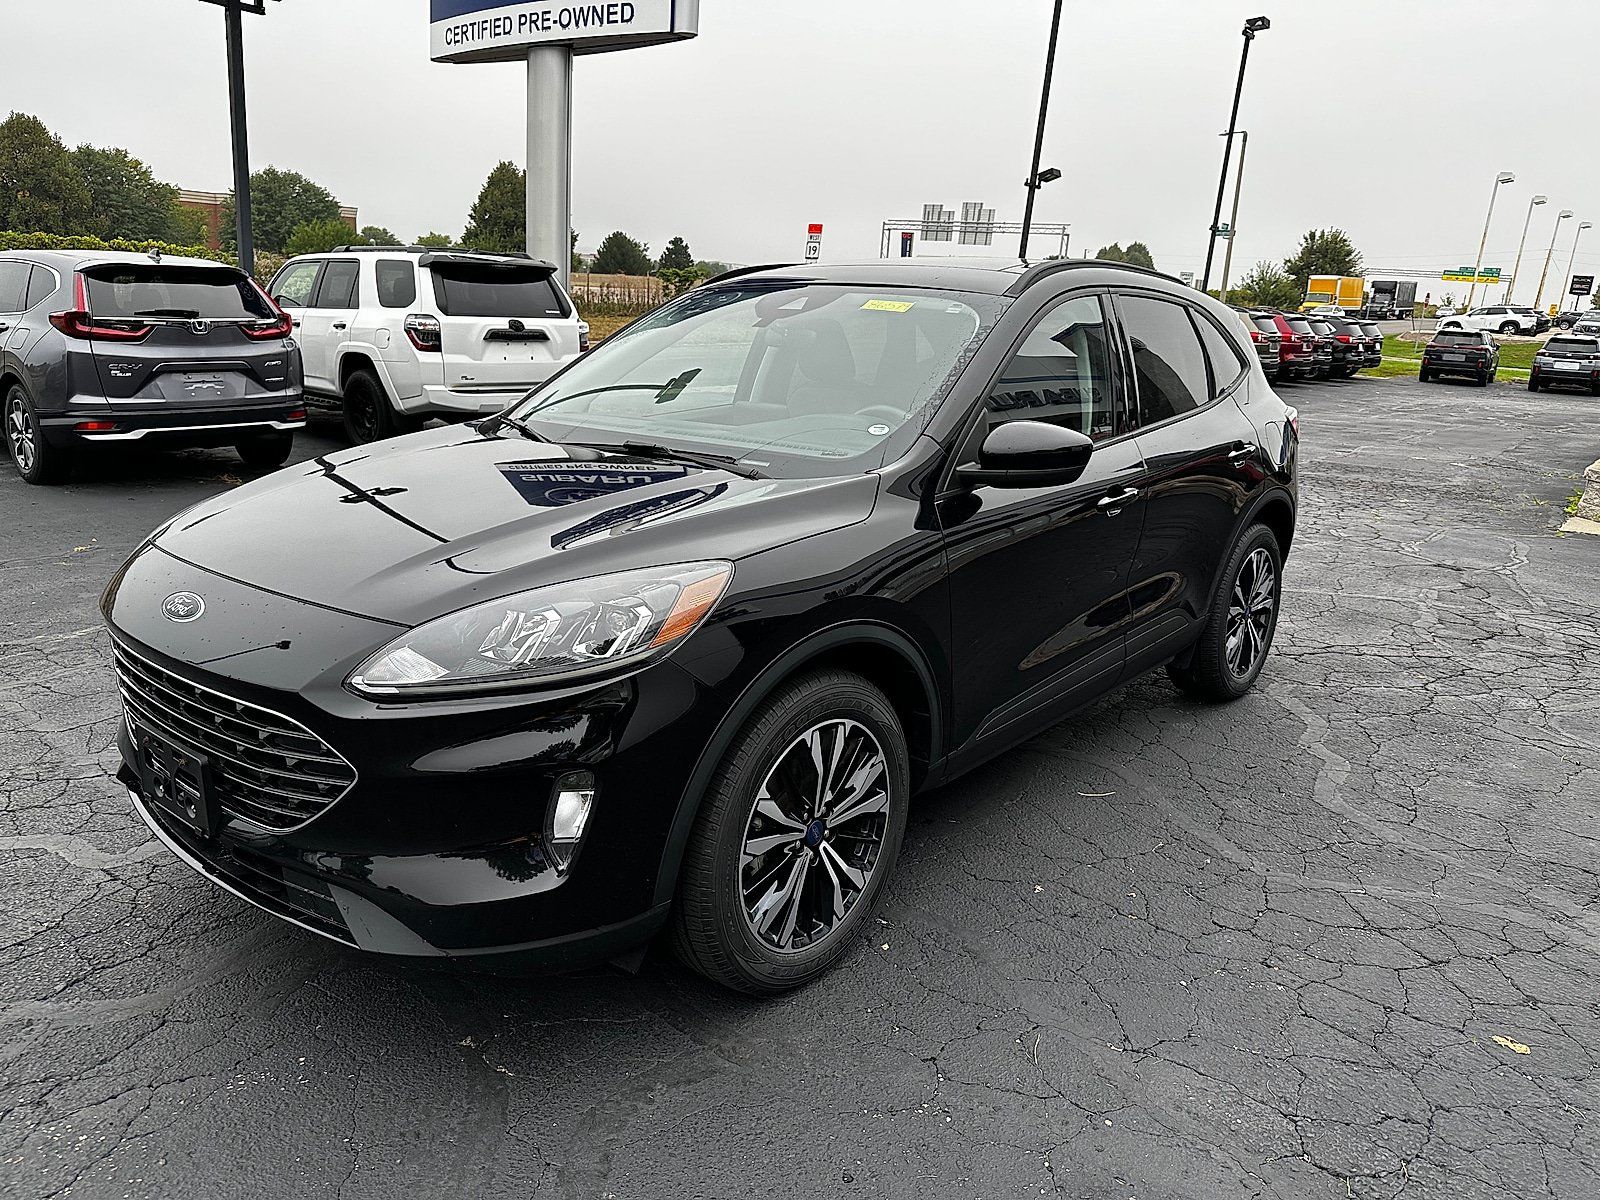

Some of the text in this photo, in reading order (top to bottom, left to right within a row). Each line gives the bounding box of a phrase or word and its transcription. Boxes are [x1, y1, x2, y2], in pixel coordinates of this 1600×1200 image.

[445, 2, 635, 46] CERTIFIED PRE-OWNED
[808, 245, 818, 255] 19
